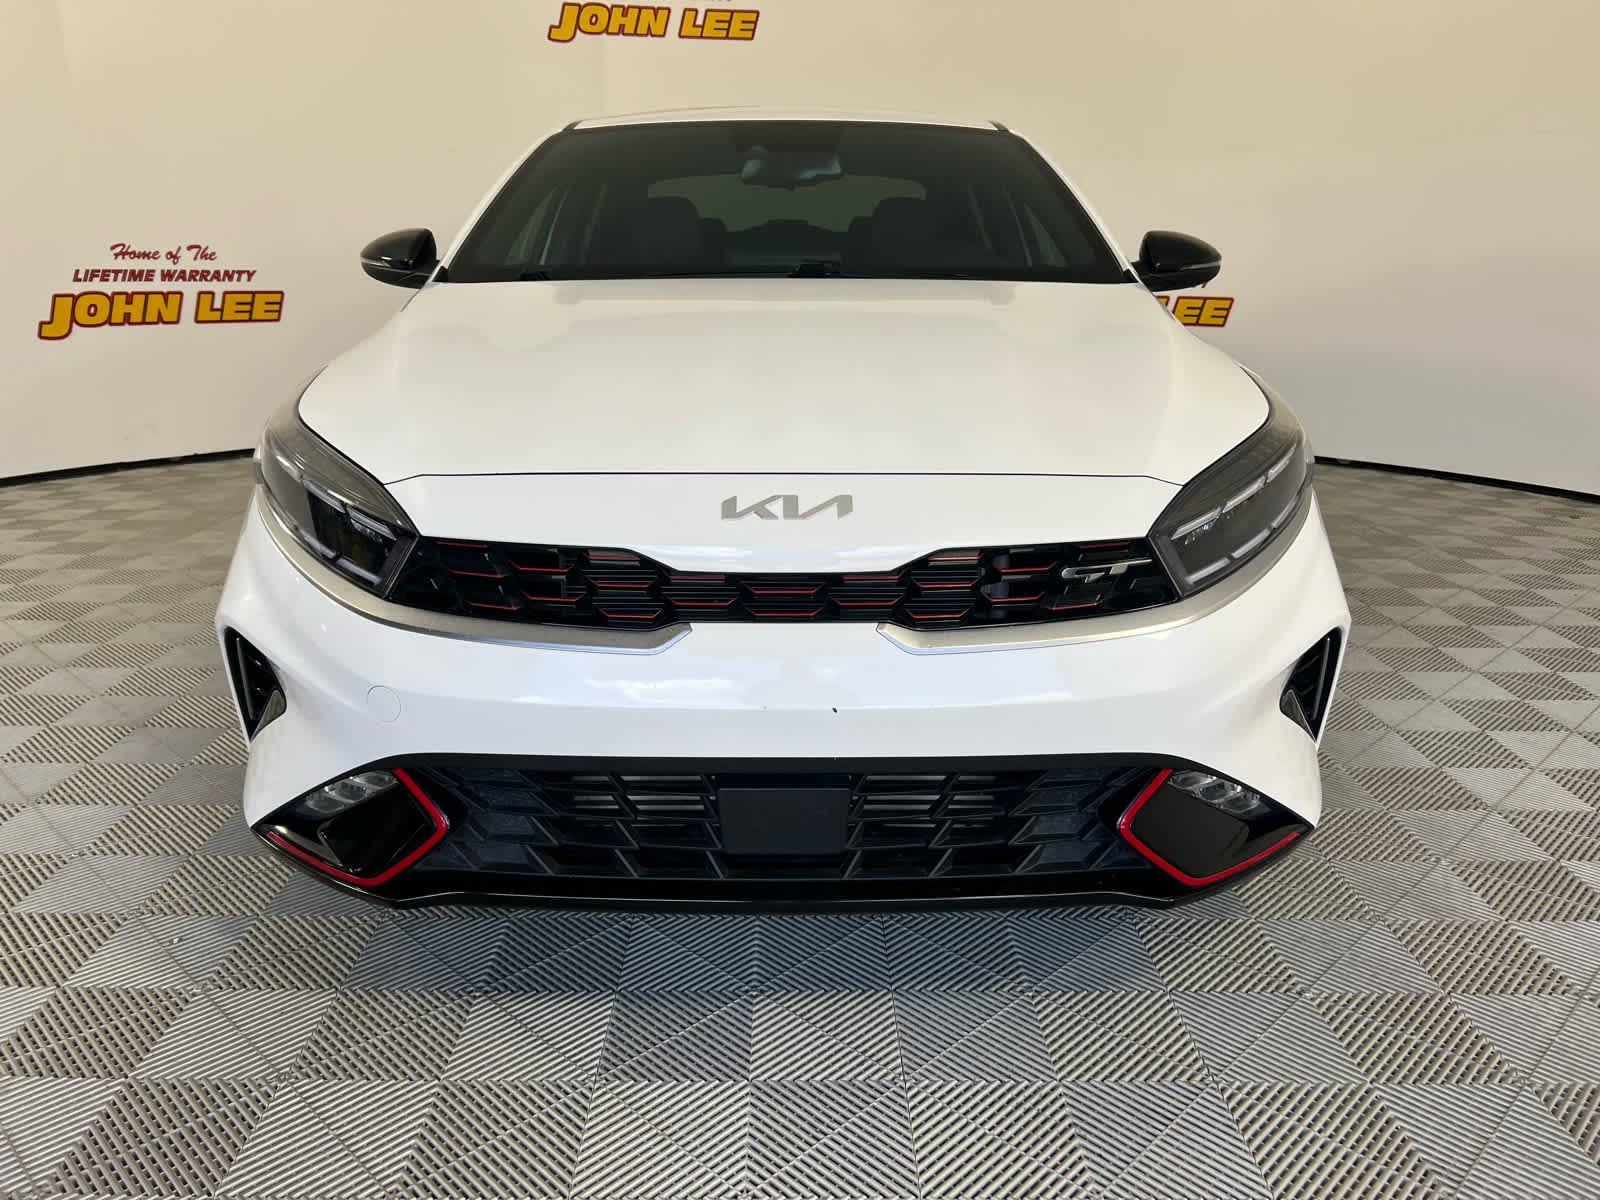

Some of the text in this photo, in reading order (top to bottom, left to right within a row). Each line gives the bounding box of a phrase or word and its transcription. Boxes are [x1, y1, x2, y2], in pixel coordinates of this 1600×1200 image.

[548, 2, 760, 42] JOHN LEE
[110, 243, 217, 265] Home of The
[73, 269, 256, 282] LIFETIME WARRANTY
[38, 291, 284, 340] JOHN LEE
[1155, 296, 1234, 327] EE
[720, 494, 853, 520] KIA
[1061, 556, 1152, 583] GT
